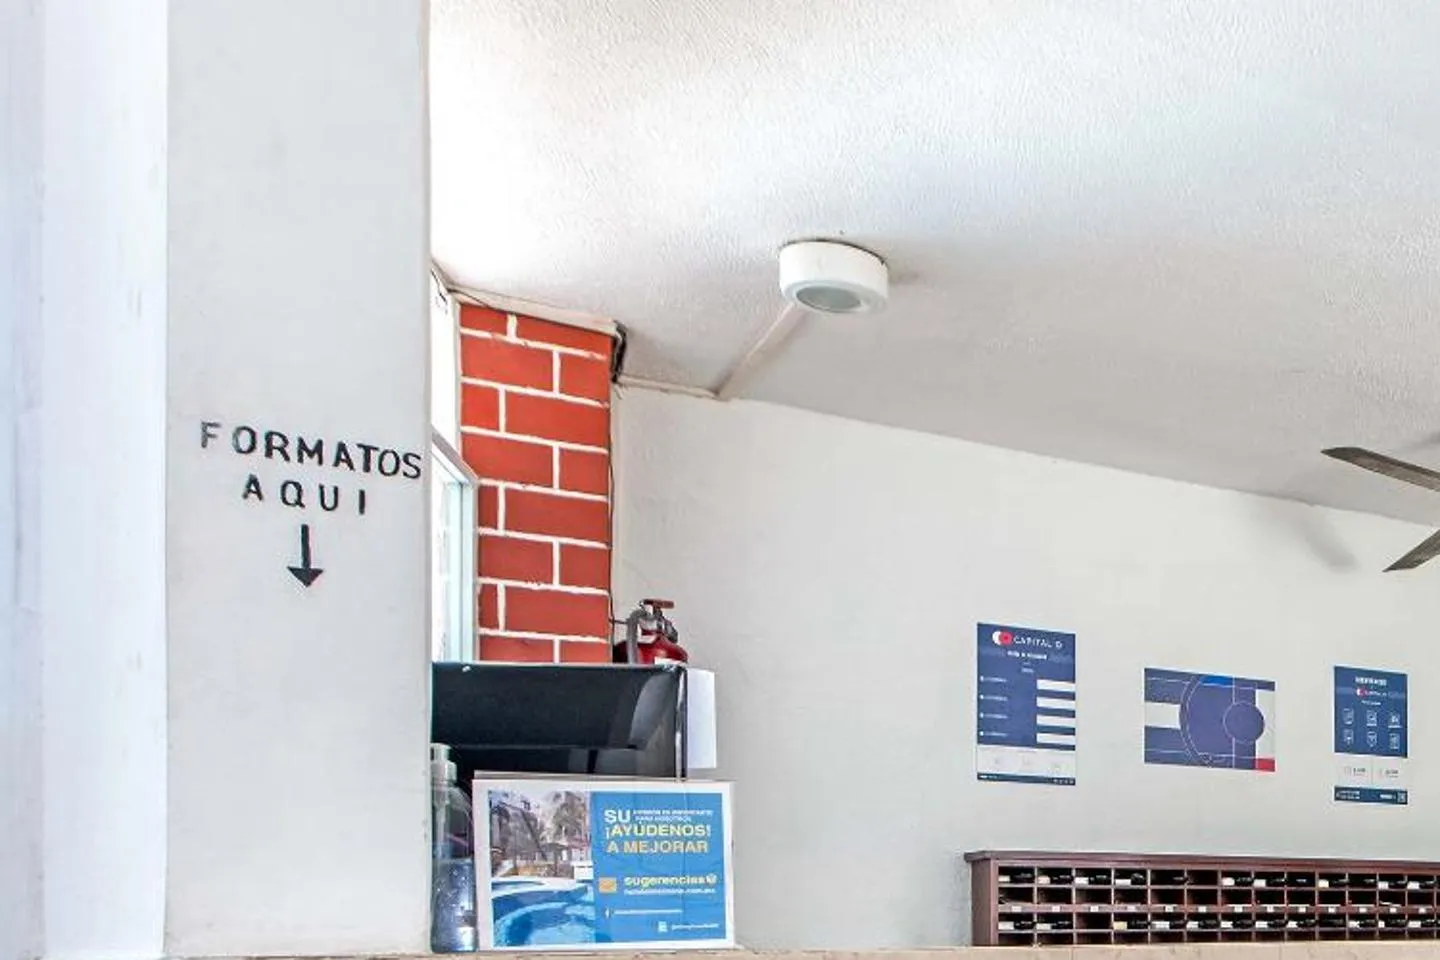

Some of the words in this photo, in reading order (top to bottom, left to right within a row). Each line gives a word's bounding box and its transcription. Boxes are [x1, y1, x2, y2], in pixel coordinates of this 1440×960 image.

[201, 421, 421, 479] FORMATOS
[241, 474, 366, 515] AQUI
[604, 809, 631, 823] SU
[606, 840, 619, 853] A
[623, 840, 709, 853] MEJORAR
